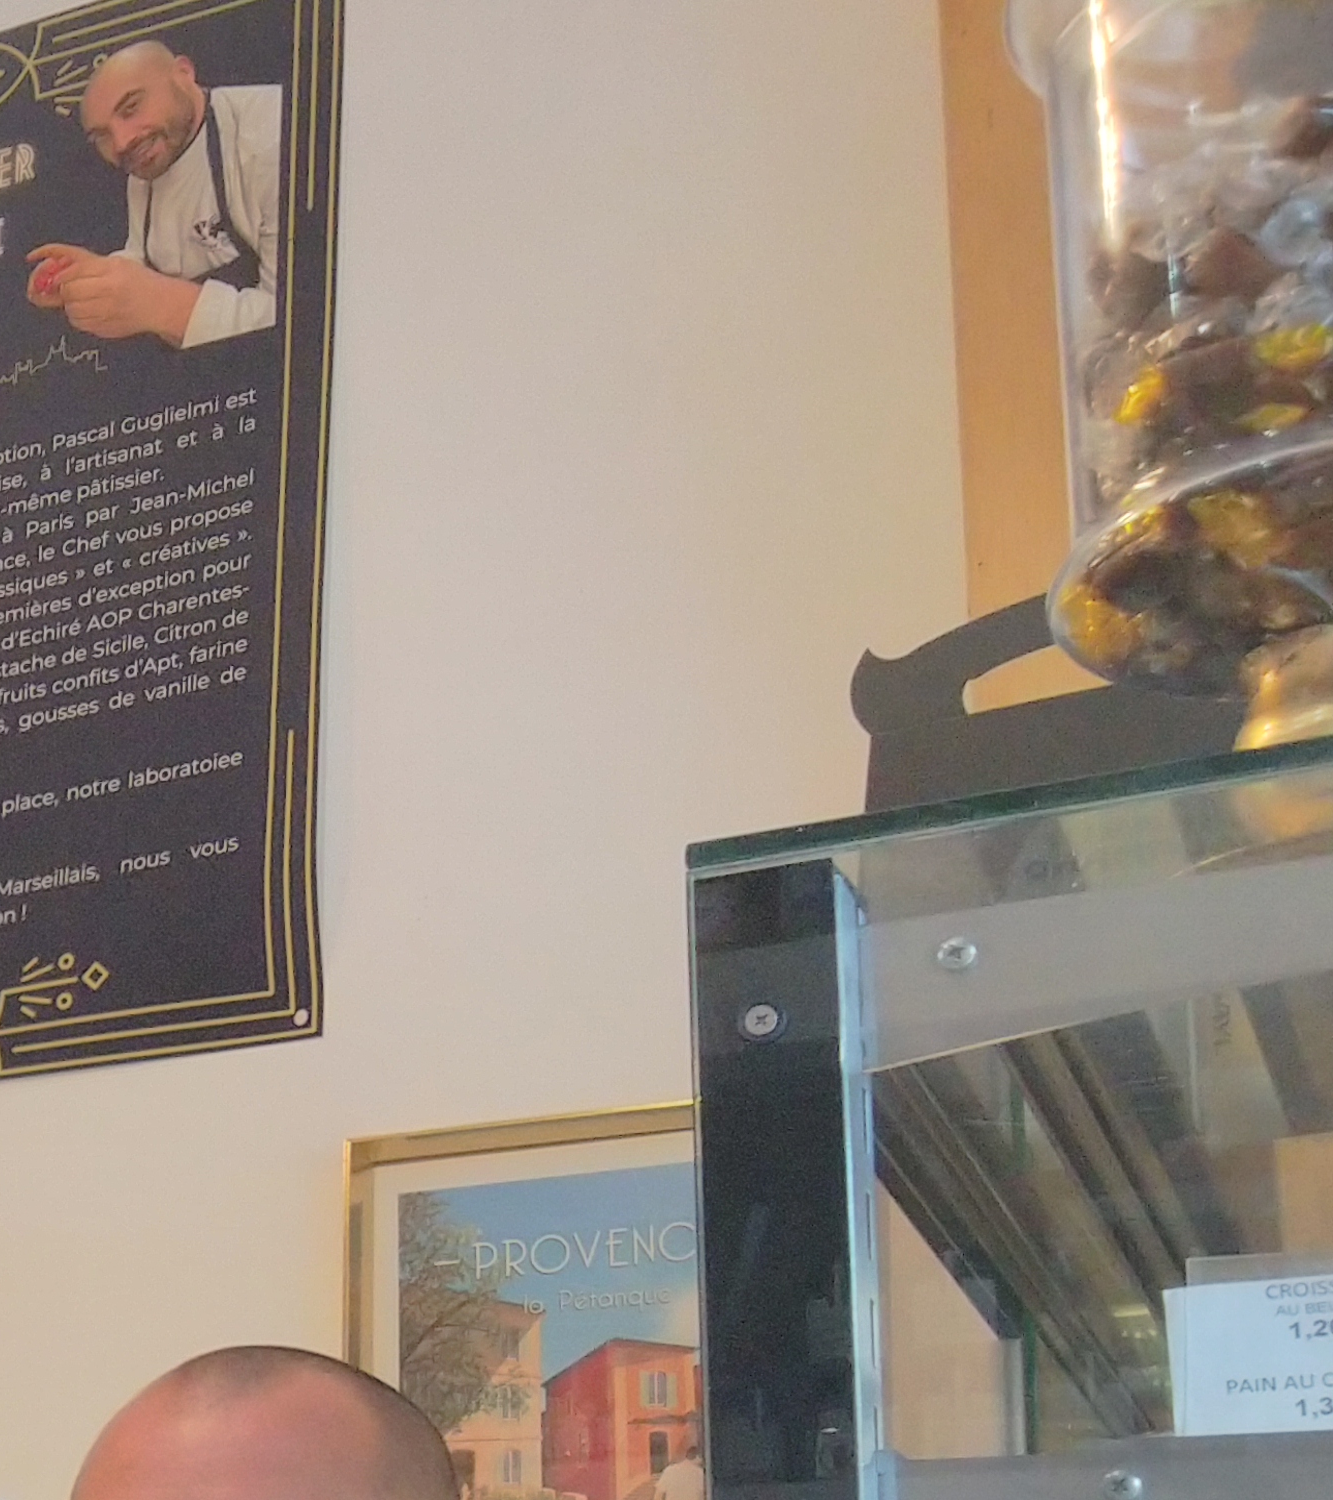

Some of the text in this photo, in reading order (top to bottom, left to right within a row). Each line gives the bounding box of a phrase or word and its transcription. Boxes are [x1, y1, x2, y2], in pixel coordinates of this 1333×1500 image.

[52, 420, 115, 451] Pascal
[120, 394, 219, 434] Guglielmi
[225, 388, 256, 409] est
[1, 526, 13, 544] à
[25, 513, 74, 538] Paris
[85, 504, 119, 528] par
[129, 467, 254, 514] Jean-Michel
[37, 544, 55, 562] le
[61, 529, 109, 556] Chef
[115, 521, 162, 544] vous
[169, 499, 253, 536] propose
[77, 568, 194, 607] d'exception
[202, 553, 251, 582] pour
[1, 791, 59, 818] place,
[66, 777, 121, 801] notre
[119, 850, 170, 873] nous
[189, 836, 239, 858] vous
[524, 1287, 672, 1314] la Pétanque
[1275, 1301, 1333, 1317] AU BE
[1288, 1318, 1333, 1341] 1,2
[1226, 1374, 1315, 1394] PAIN AU
